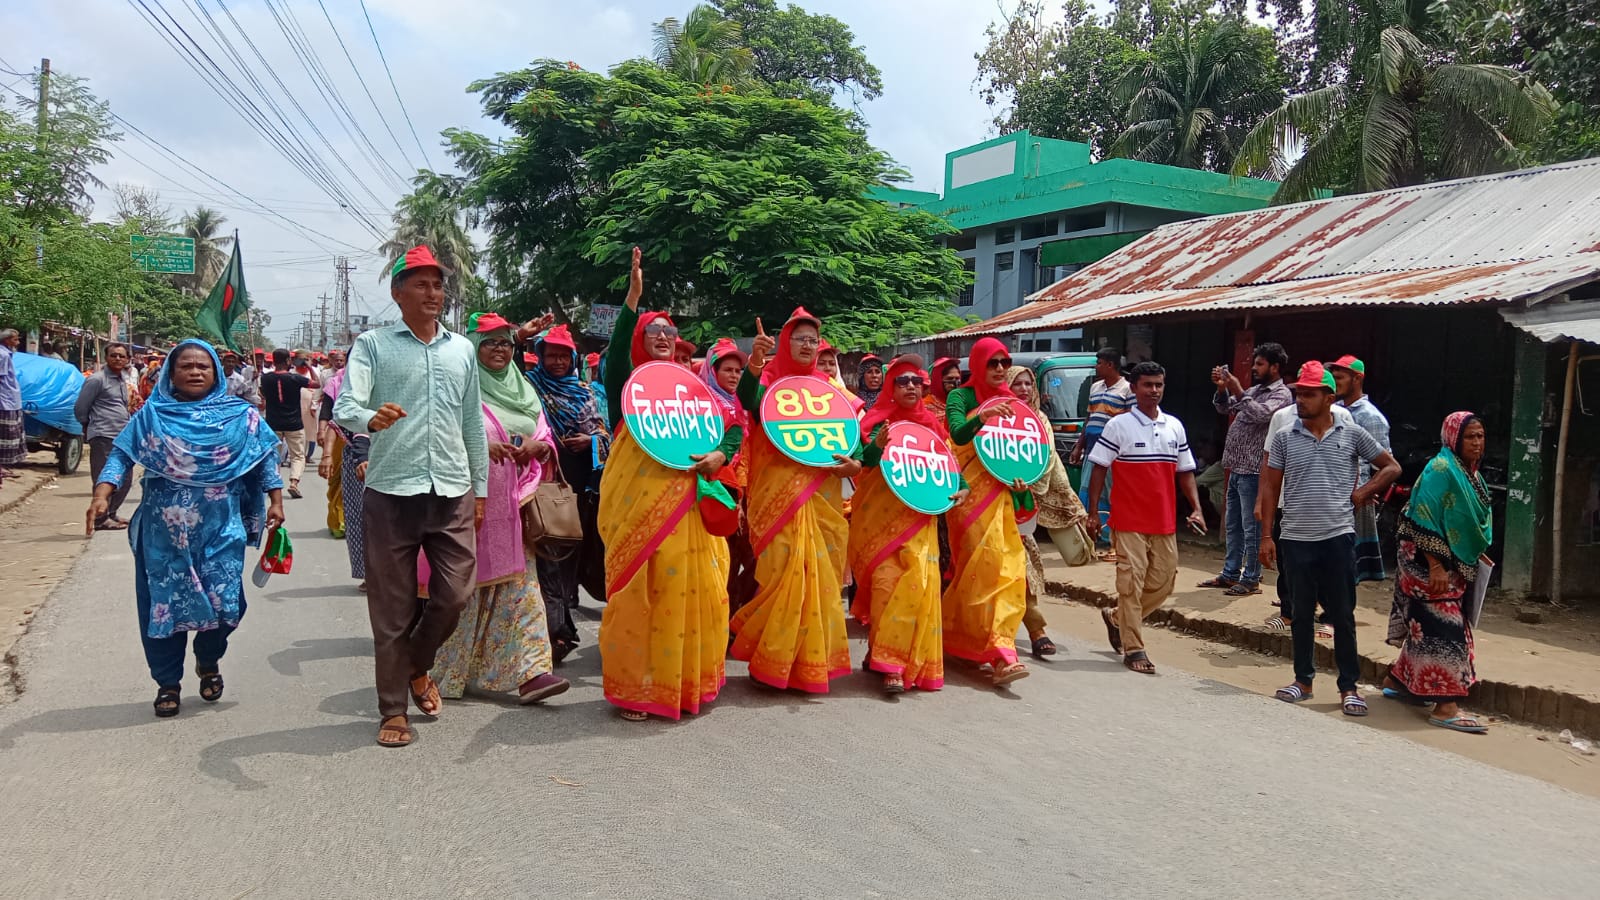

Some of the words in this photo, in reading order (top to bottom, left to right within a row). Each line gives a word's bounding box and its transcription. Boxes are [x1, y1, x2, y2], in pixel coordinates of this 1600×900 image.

[775, 387, 834, 417] ৪৮
[779, 422, 849, 452] তম
[889, 434, 952, 488] প্রতিষ্ঠা
